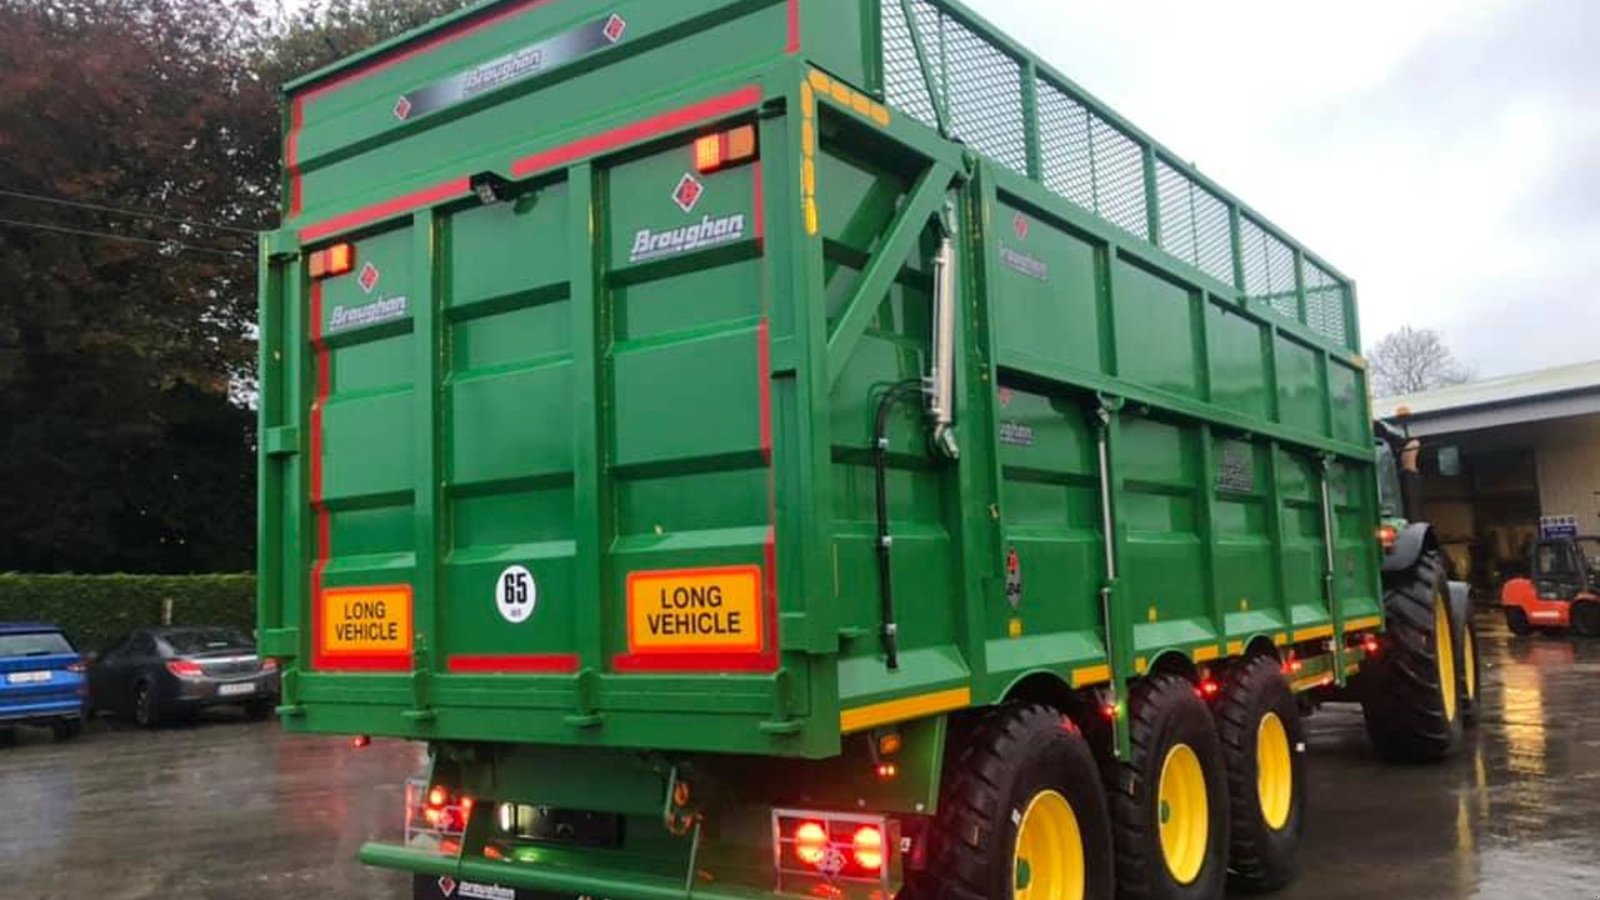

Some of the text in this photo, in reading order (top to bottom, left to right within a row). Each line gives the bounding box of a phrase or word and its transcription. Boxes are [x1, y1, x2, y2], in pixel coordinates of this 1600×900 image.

[465, 50, 541, 90] Broughan
[631, 214, 744, 259] Broughan
[330, 296, 406, 331] Broughan
[504, 572, 527, 604] 65
[661, 586, 722, 609] LONG
[345, 602, 386, 620] LONG
[647, 611, 741, 635] VEHICLE
[336, 622, 398, 641] VEHICLE
